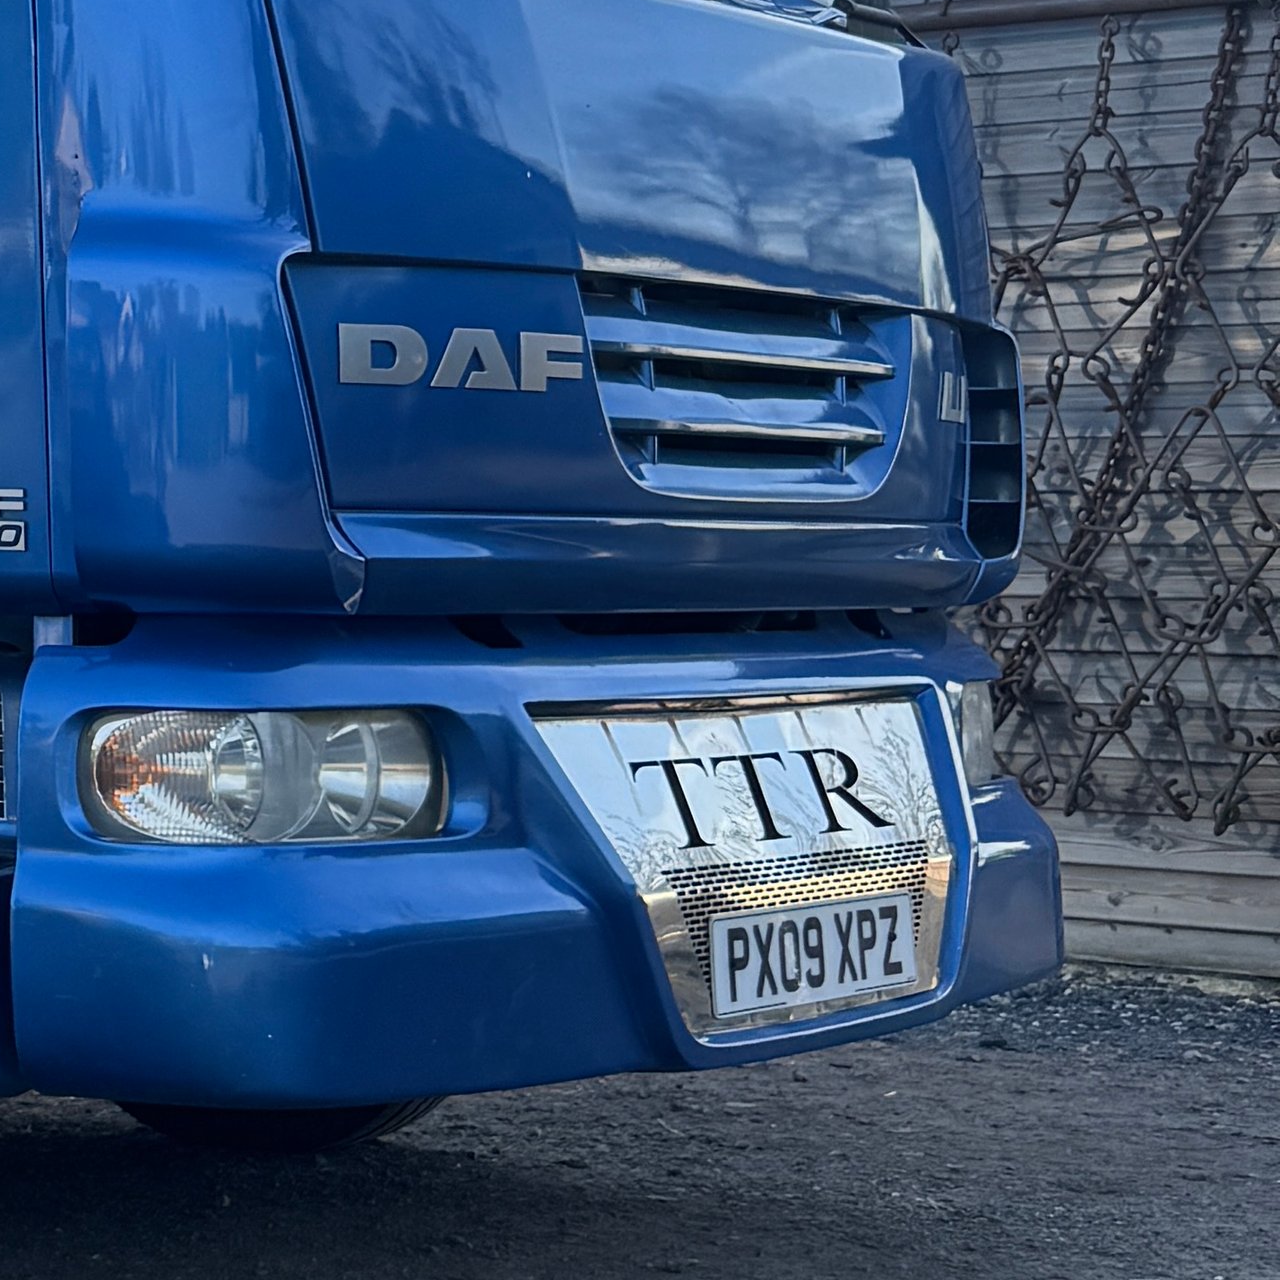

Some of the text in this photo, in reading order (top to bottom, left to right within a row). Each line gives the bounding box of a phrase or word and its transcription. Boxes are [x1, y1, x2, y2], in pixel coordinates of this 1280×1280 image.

[338, 323, 583, 392] DAF
[629, 747, 896, 849] TTR
[726, 905, 905, 1003] PX09 XPZ
